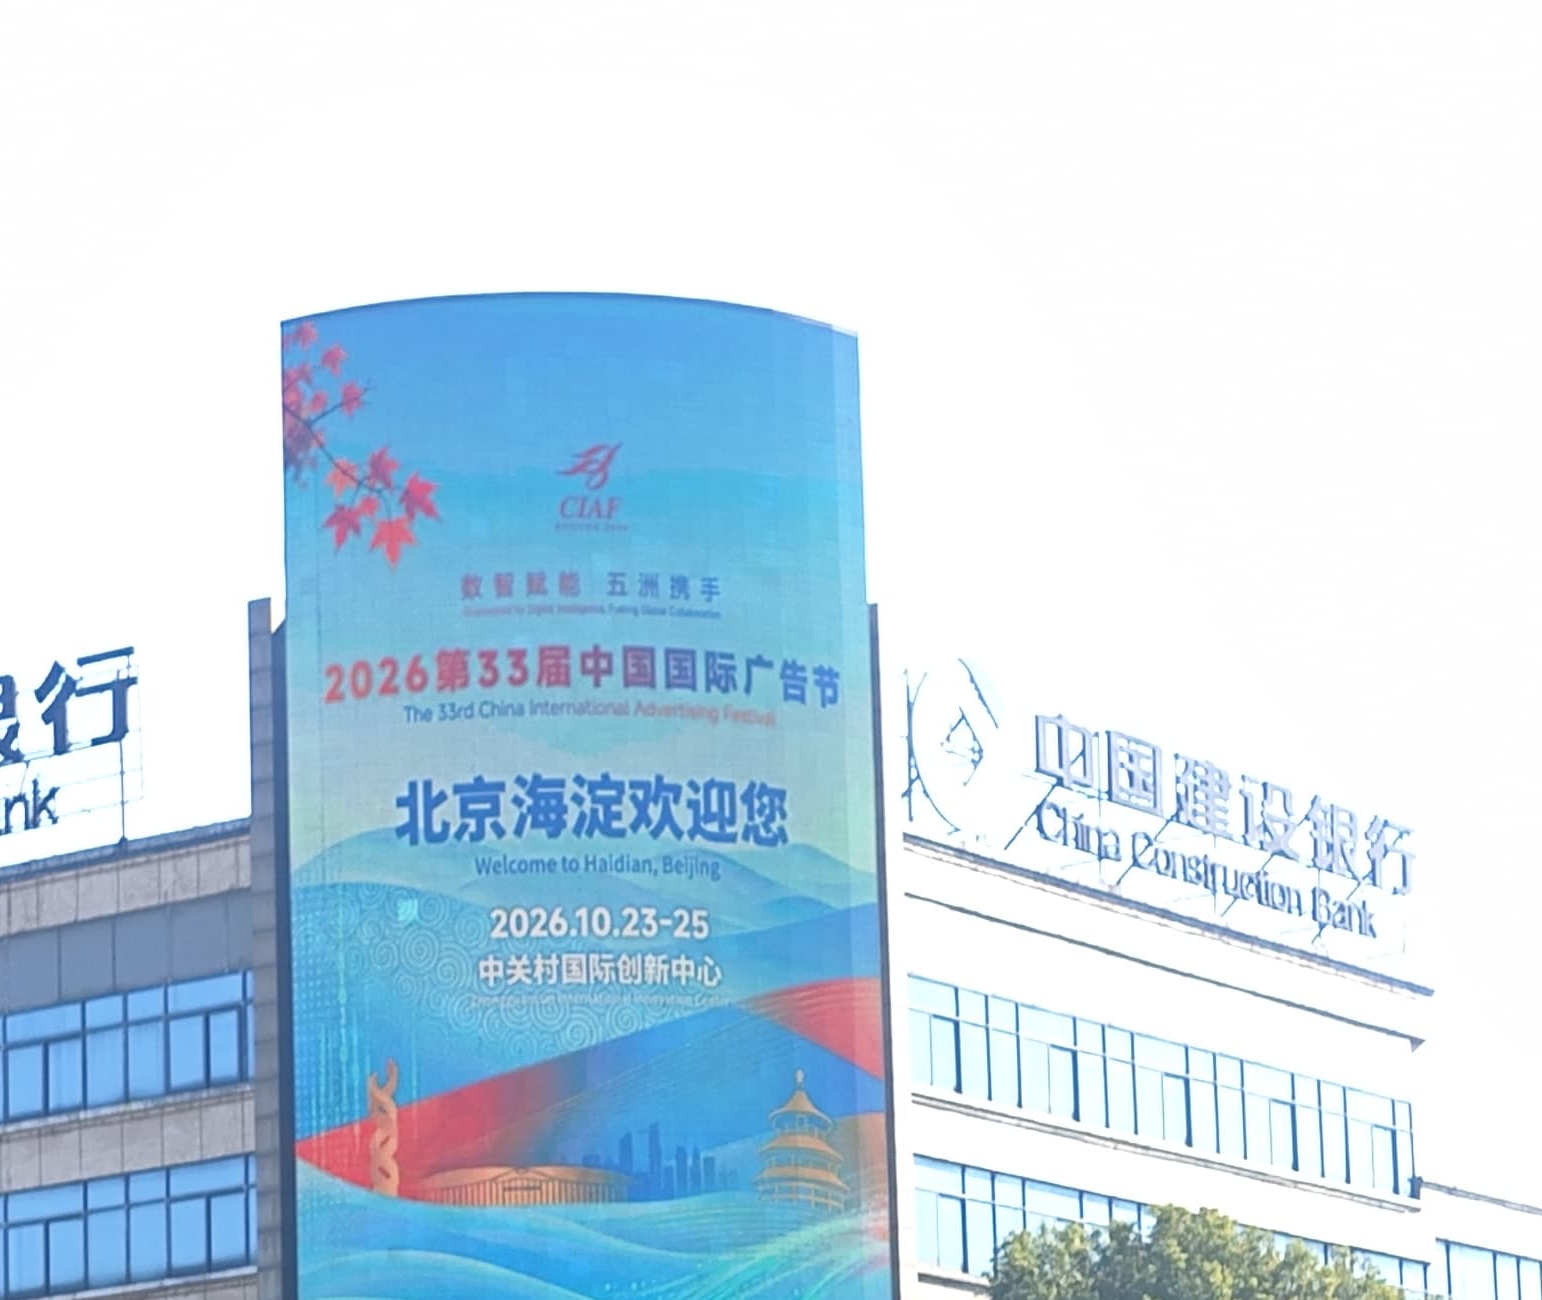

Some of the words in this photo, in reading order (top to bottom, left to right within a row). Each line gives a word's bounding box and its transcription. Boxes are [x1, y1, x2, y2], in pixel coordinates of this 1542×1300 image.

[559, 496, 622, 520] CIAF
[606, 570, 721, 602] 五洲携手
[323, 644, 840, 709] 2026第33届中国国际广告节
[404, 705, 433, 723] The
[438, 701, 475, 721] 33rd
[479, 700, 525, 719] China
[530, 698, 627, 718] International
[633, 702, 720, 726] Advertising
[395, 772, 790, 847] 北京海淀欢迎您
[1034, 713, 1418, 896] 中国建设银行
[475, 855, 557, 875] Welcome
[561, 855, 580, 874] to
[584, 854, 659, 877] Haidian,
[662, 855, 722, 880] Beijing
[1036, 800, 1122, 862] China
[1131, 831, 1303, 917] Construction
[1312, 886, 1378, 939] Bank
[489, 906, 710, 940] 2026.10.23-25
[478, 953, 723, 988] 中关村国际创新中心
